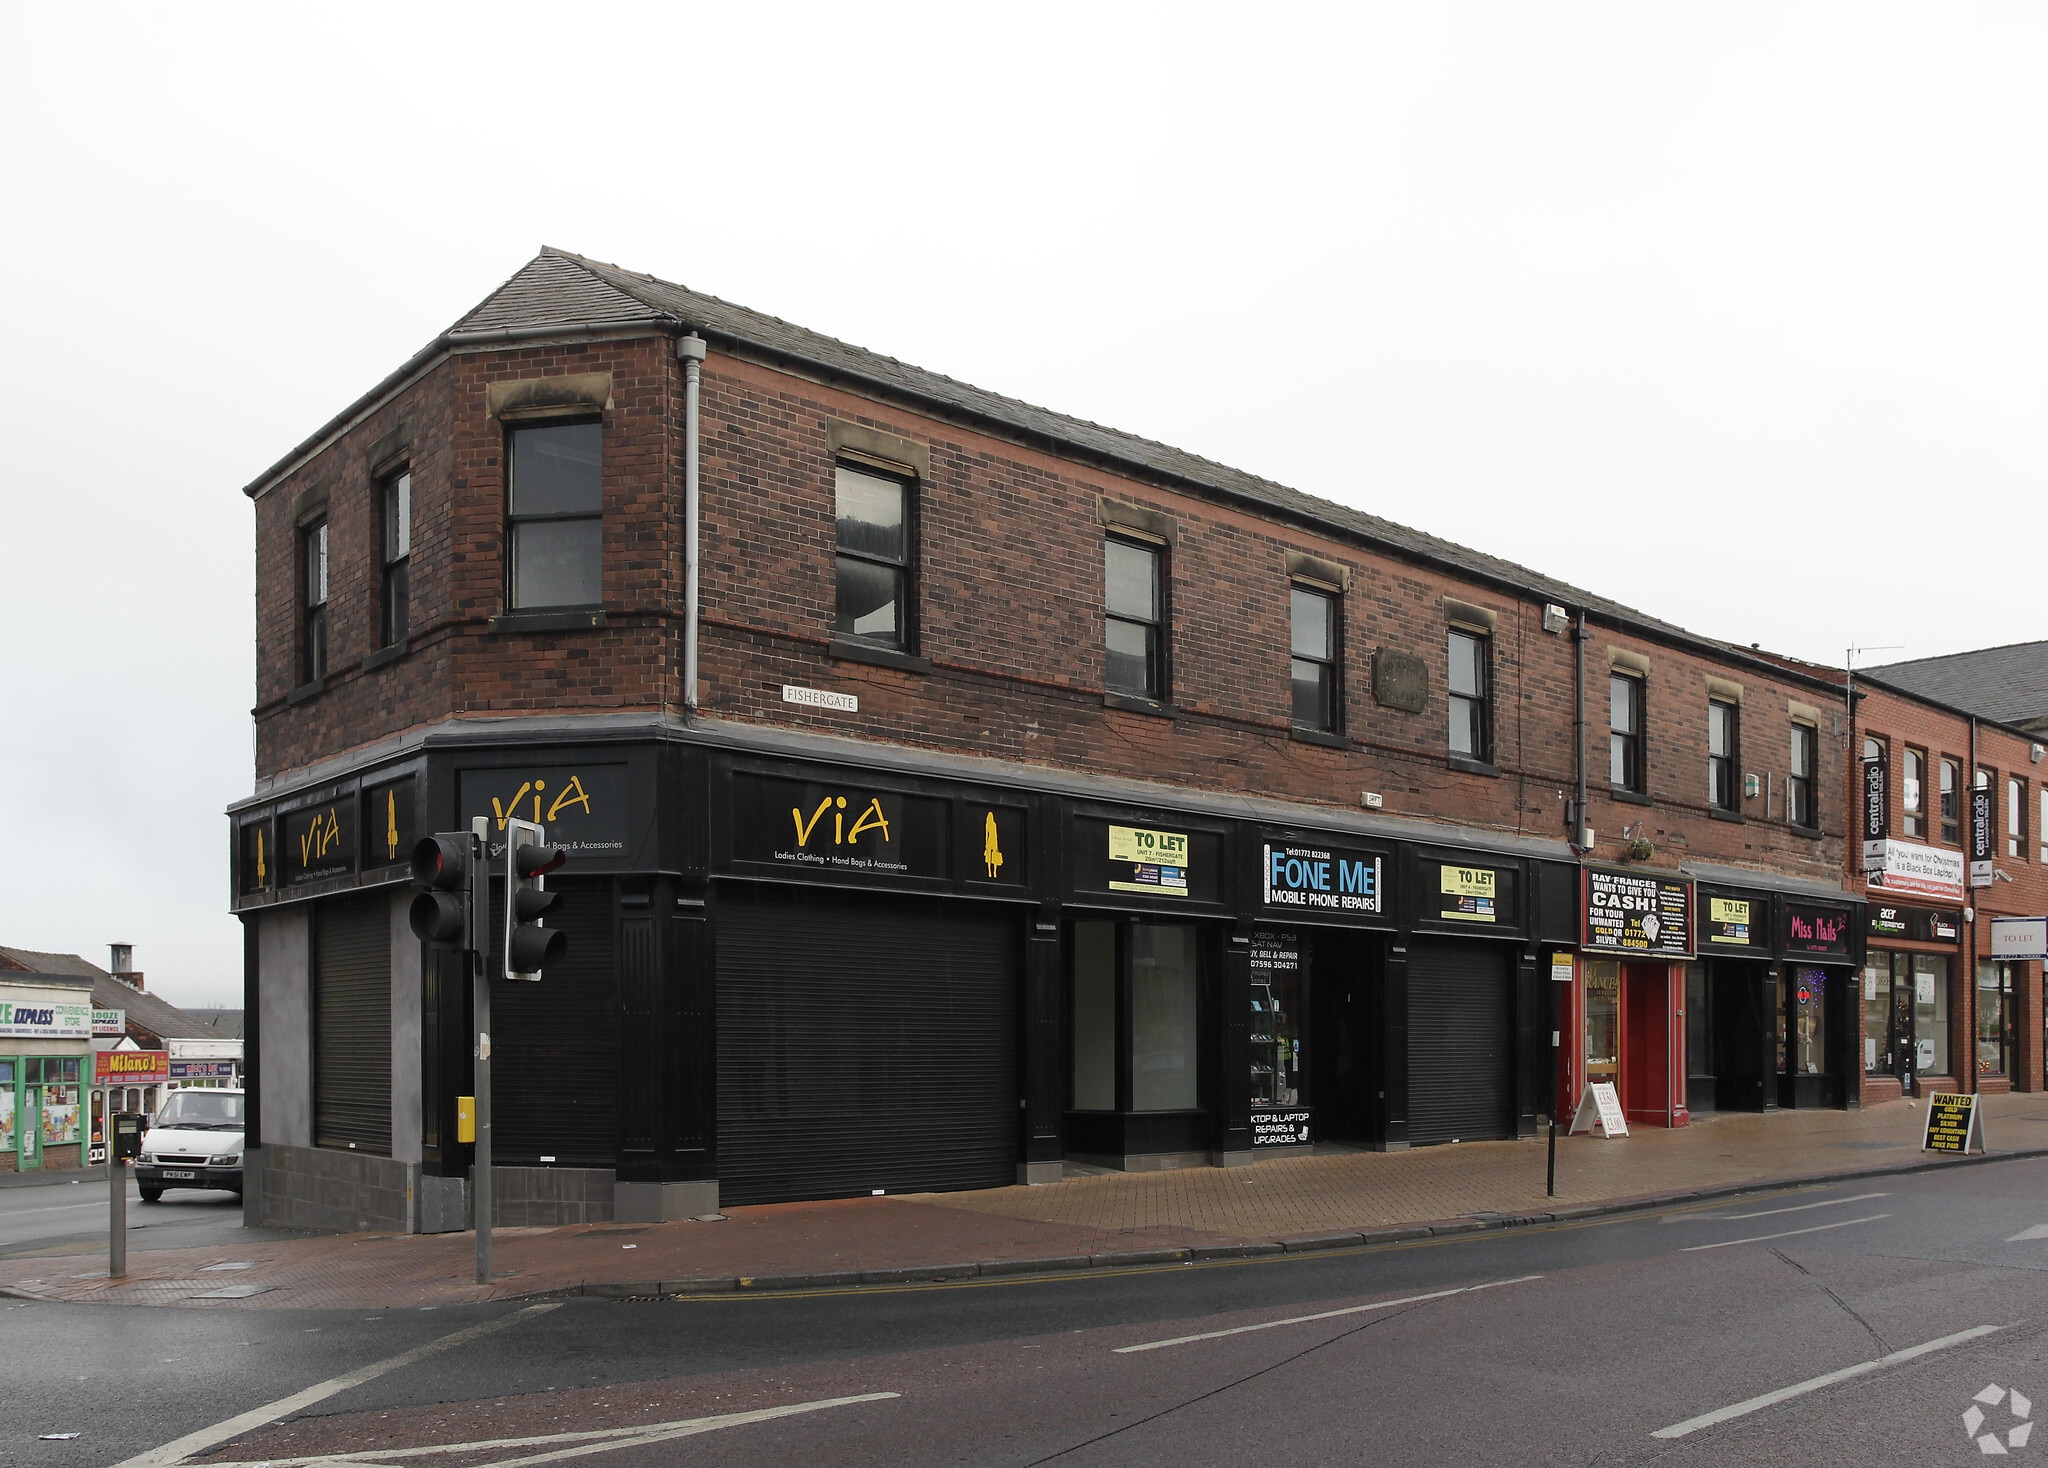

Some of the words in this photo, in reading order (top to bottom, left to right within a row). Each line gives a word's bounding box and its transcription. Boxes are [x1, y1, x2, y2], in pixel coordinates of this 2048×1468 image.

[787, 688, 854, 709] FISHERGATE
[552, 842, 570, 850] Bags
[572, 842, 578, 850] &
[580, 840, 622, 849] Accessories
[1134, 831, 1155, 848] TO
[1160, 834, 1185, 852] LET
[774, 850, 796, 861] Ladies
[797, 852, 824, 864] Clothing
[832, 855, 850, 866] Hand
[850, 857, 866, 868] Bags
[867, 859, 872, 867] &
[874, 860, 908, 870] Accessories
[1156, 852, 1183, 860] FISHERGATE
[1933, 854, 1960, 868] Christmas
[1272, 851, 1330, 891] FONE
[1906, 862, 1922, 873] Black
[1458, 870, 1472, 884] TO
[1475, 872, 1493, 886] LET
[1592, 873, 1612, 883] RAY
[1613, 876, 1657, 889] FRANCES
[1593, 881, 1616, 893] WANTS
[1618, 884, 1627, 894] TO
[1627, 886, 1642, 896] GIVE
[1643, 888, 1656, 897] YOU
[1272, 889, 1306, 905] MOBILE
[1309, 892, 1339, 908] PHONE
[1342, 896, 1374, 911] REPAIRS
[1590, 907, 1604, 917] FOR
[1605, 909, 1624, 919] YOUR
[1723, 902, 1732, 912] TO
[1734, 902, 1748, 914] LET
[1880, 908, 1898, 919] acer
[1590, 917, 1624, 928] UNWANTED
[1630, 919, 1640, 928] Tel
[1791, 915, 1812, 939] Miss
[1816, 917, 1837, 941] Nails
[1254, 932, 1275, 940] XBOX
[1595, 926, 1612, 935] GOLD
[1613, 928, 1622, 936] OR
[1624, 929, 1646, 938] 01772
[1267, 941, 1282, 949] NAV
[1595, 935, 1617, 945] SILVER
[1622, 939, 1648, 948] 884500
[1259, 951, 1272, 959] SELL
[1273, 951, 1278, 959] &
[1279, 952, 1298, 960] REPAIR
[1250, 960, 1272, 968] 07596
[1274, 961, 1298, 969] 304271
[56, 1005, 90, 1016] CONVENIENCE
[14, 1008, 54, 1026] EXPRESS
[64, 1016, 80, 1026] STORE
[110, 1054, 156, 1074] Milano's
[1934, 1095, 1972, 1106] WANTED
[1272, 1114, 1277, 1123] &
[1278, 1113, 1310, 1122] LAPTOP
[1255, 1124, 1288, 1134] REPAIRS
[1288, 1124, 1295, 1132] &
[1254, 1134, 1296, 1144] UPGRADES
